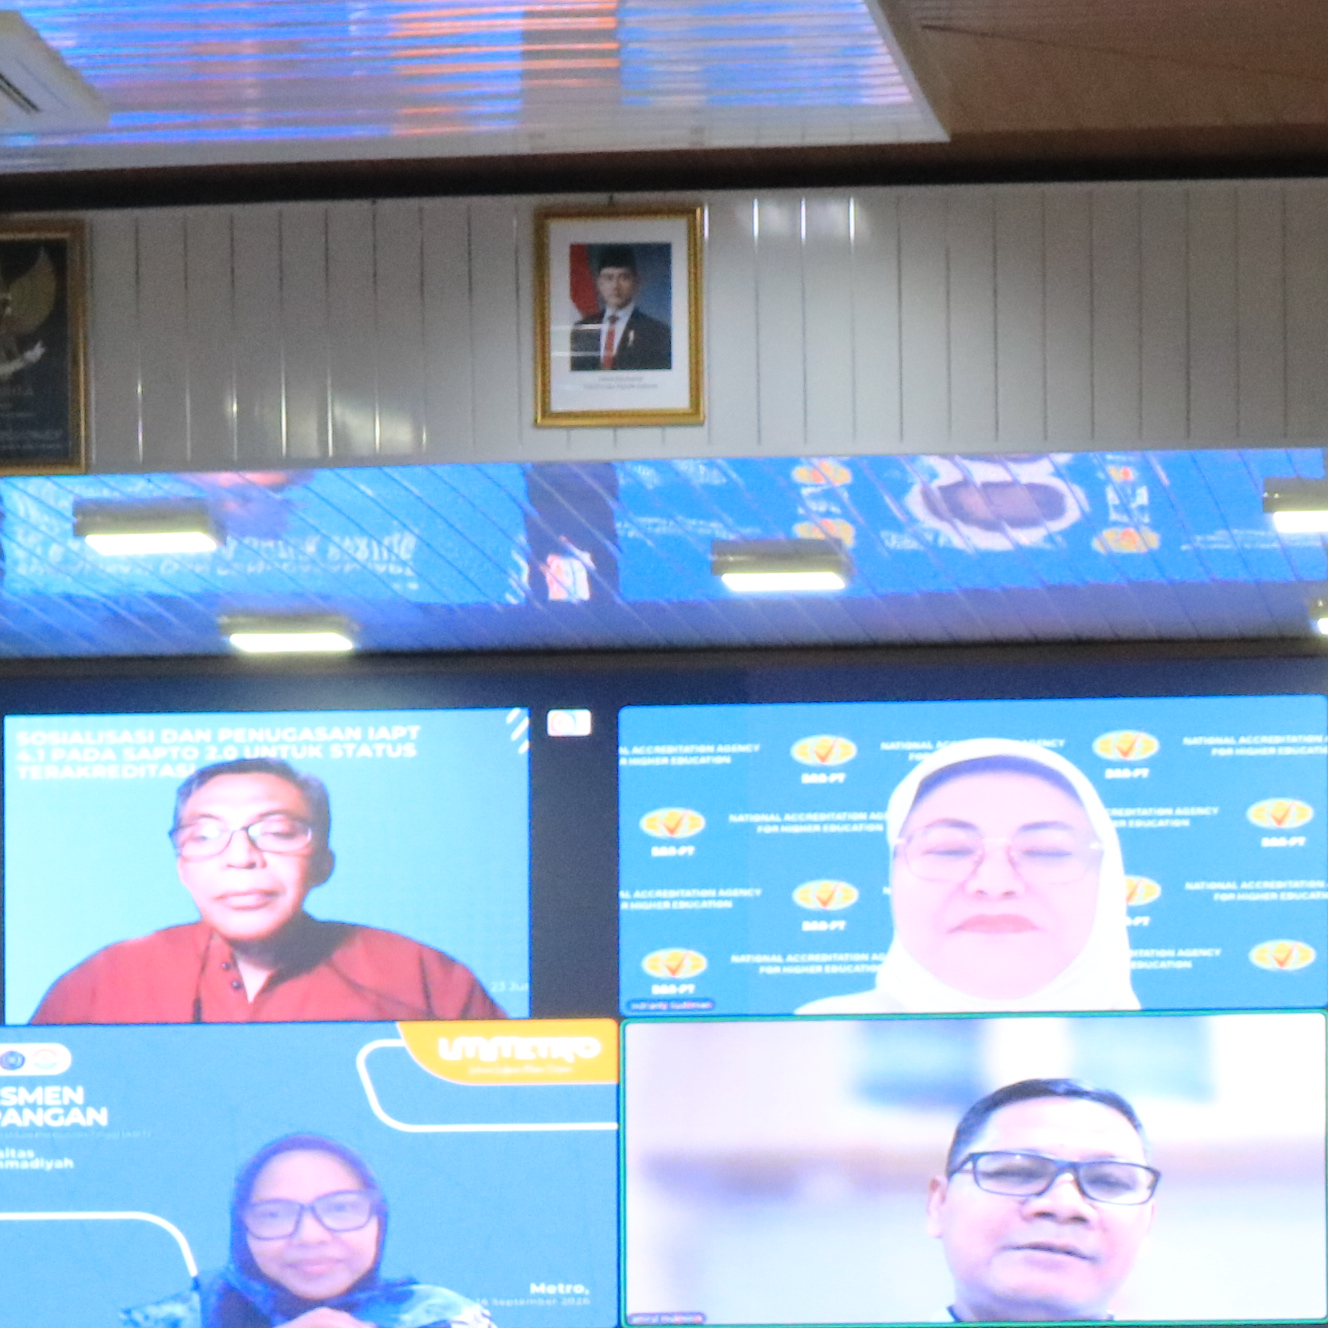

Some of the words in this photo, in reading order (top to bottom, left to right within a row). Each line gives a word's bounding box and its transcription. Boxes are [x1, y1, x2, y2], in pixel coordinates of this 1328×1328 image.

[16, 728, 154, 745] SOSIALISASI
[161, 727, 211, 744] DAN
[217, 726, 362, 744] PENUGASAN
[368, 725, 421, 741] IAPT
[51, 746, 117, 762] PADA
[122, 746, 199, 761] SAPTO
[204, 745, 238, 760] 2.0
[244, 743, 323, 760] UNTUK
[329, 742, 418, 758] STATUS
[1277, 745, 1328, 755] EDUCATI
[529, 1282, 590, 1297] Metro,
